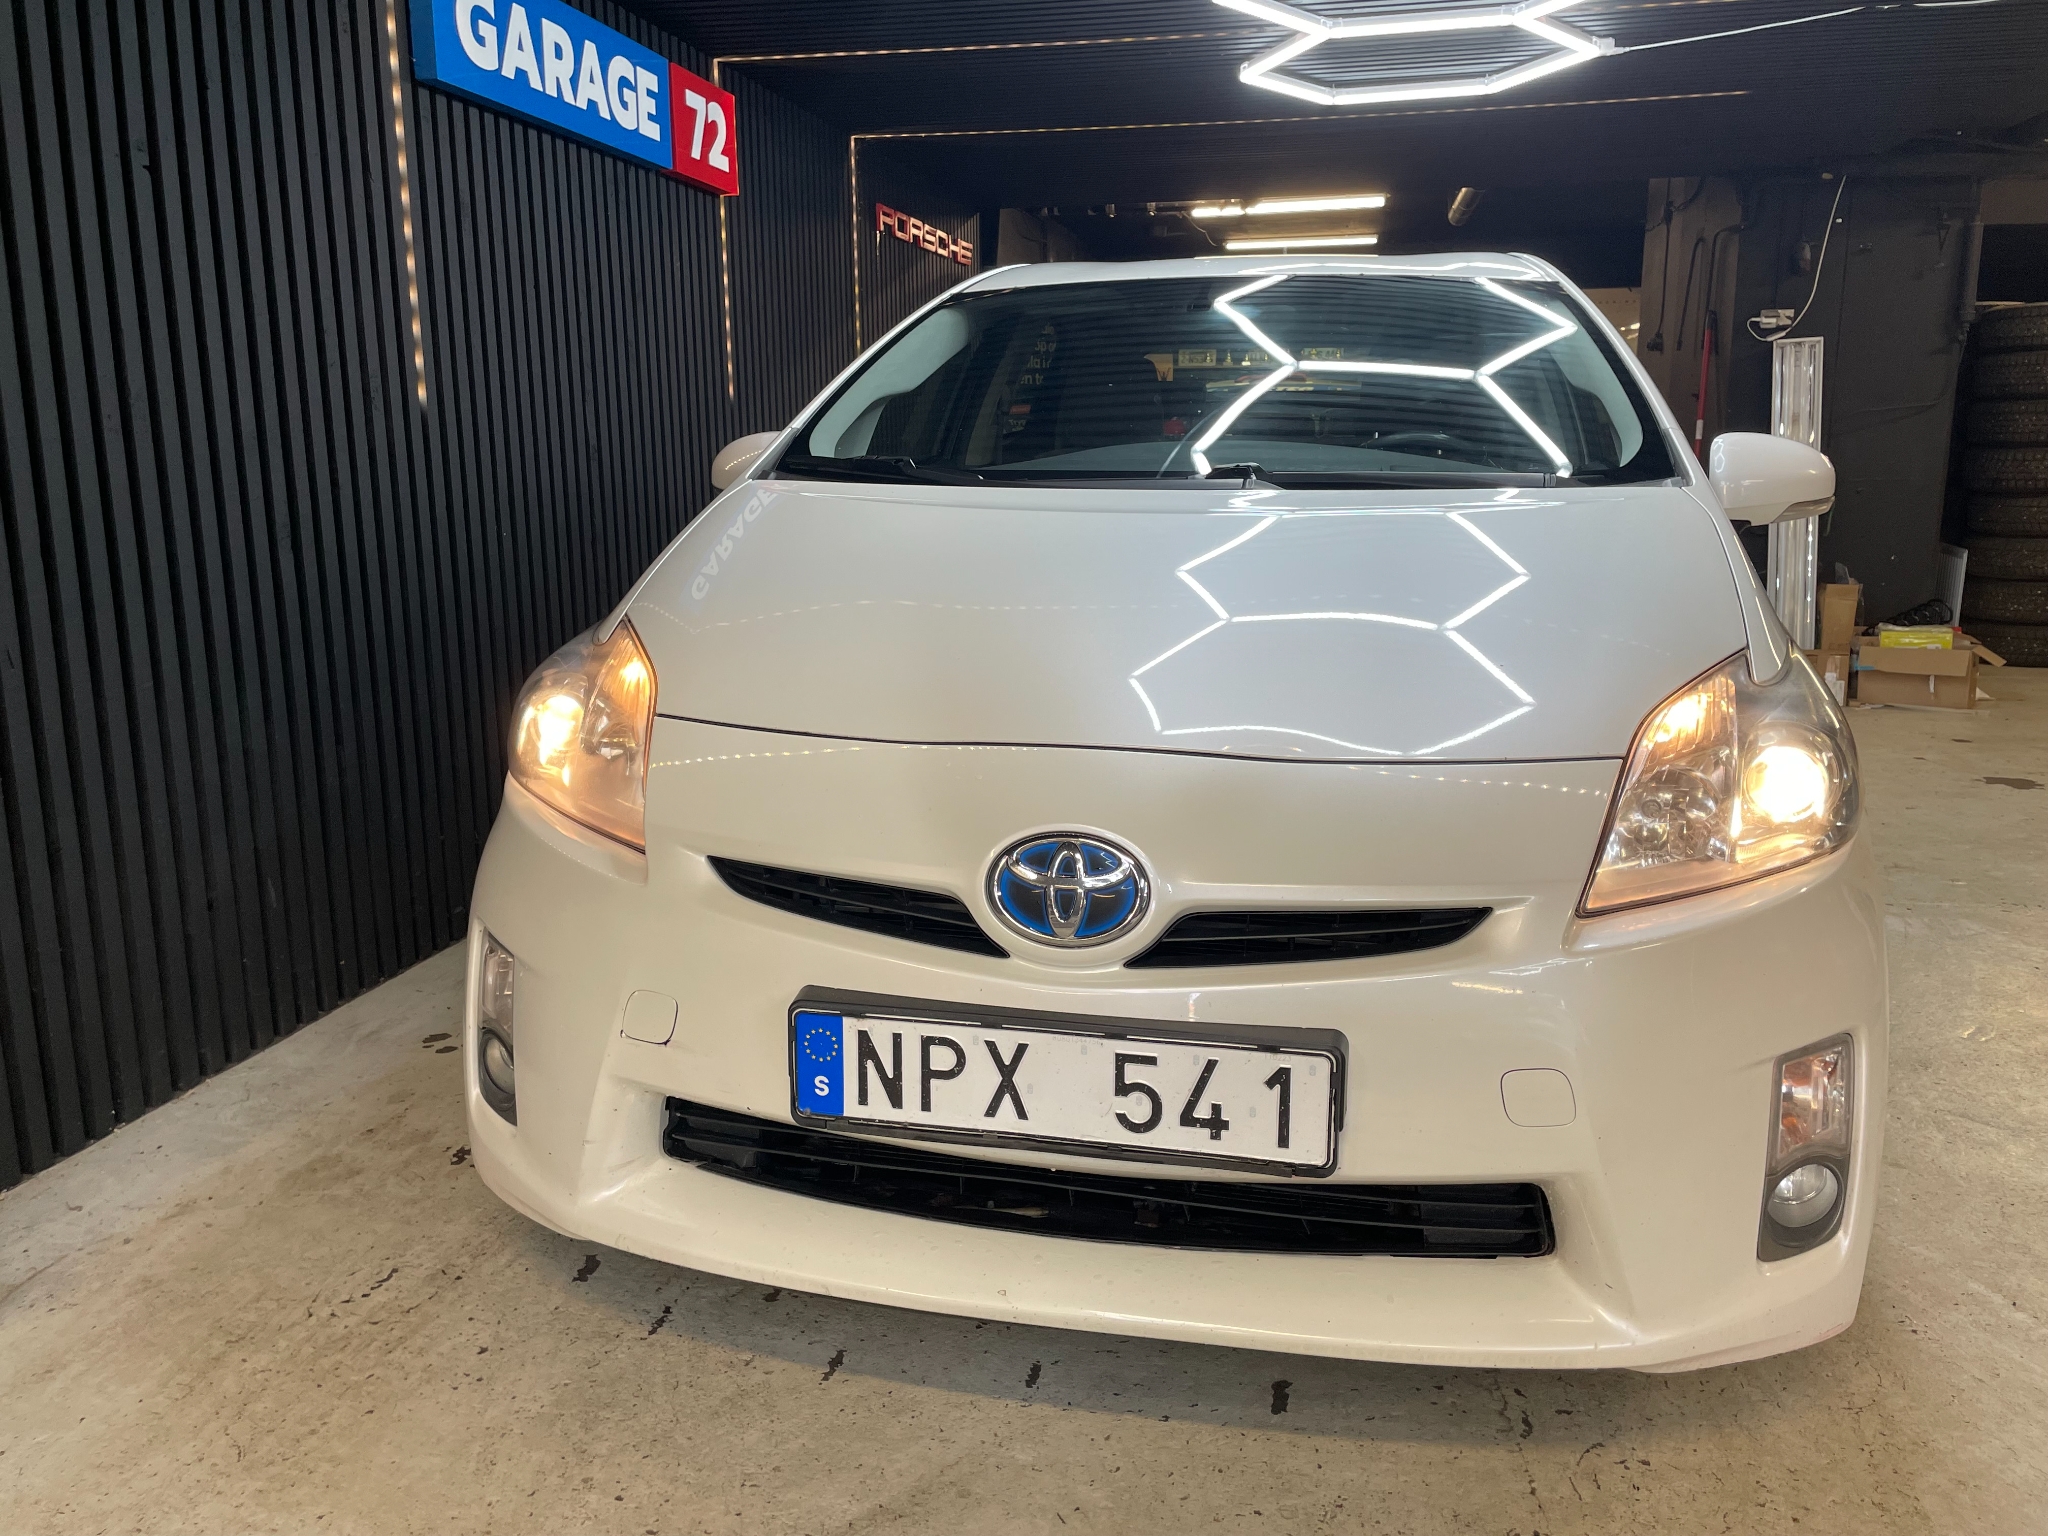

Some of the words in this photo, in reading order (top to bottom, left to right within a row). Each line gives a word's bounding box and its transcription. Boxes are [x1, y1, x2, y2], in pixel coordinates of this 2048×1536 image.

[455, 0, 661, 142] GARAGE
[685, 88, 730, 173] 72
[876, 203, 973, 266] PORSCHE
[814, 1075, 830, 1097] S
[857, 1028, 1030, 1121] NPX
[1114, 1051, 1292, 1149] 541
